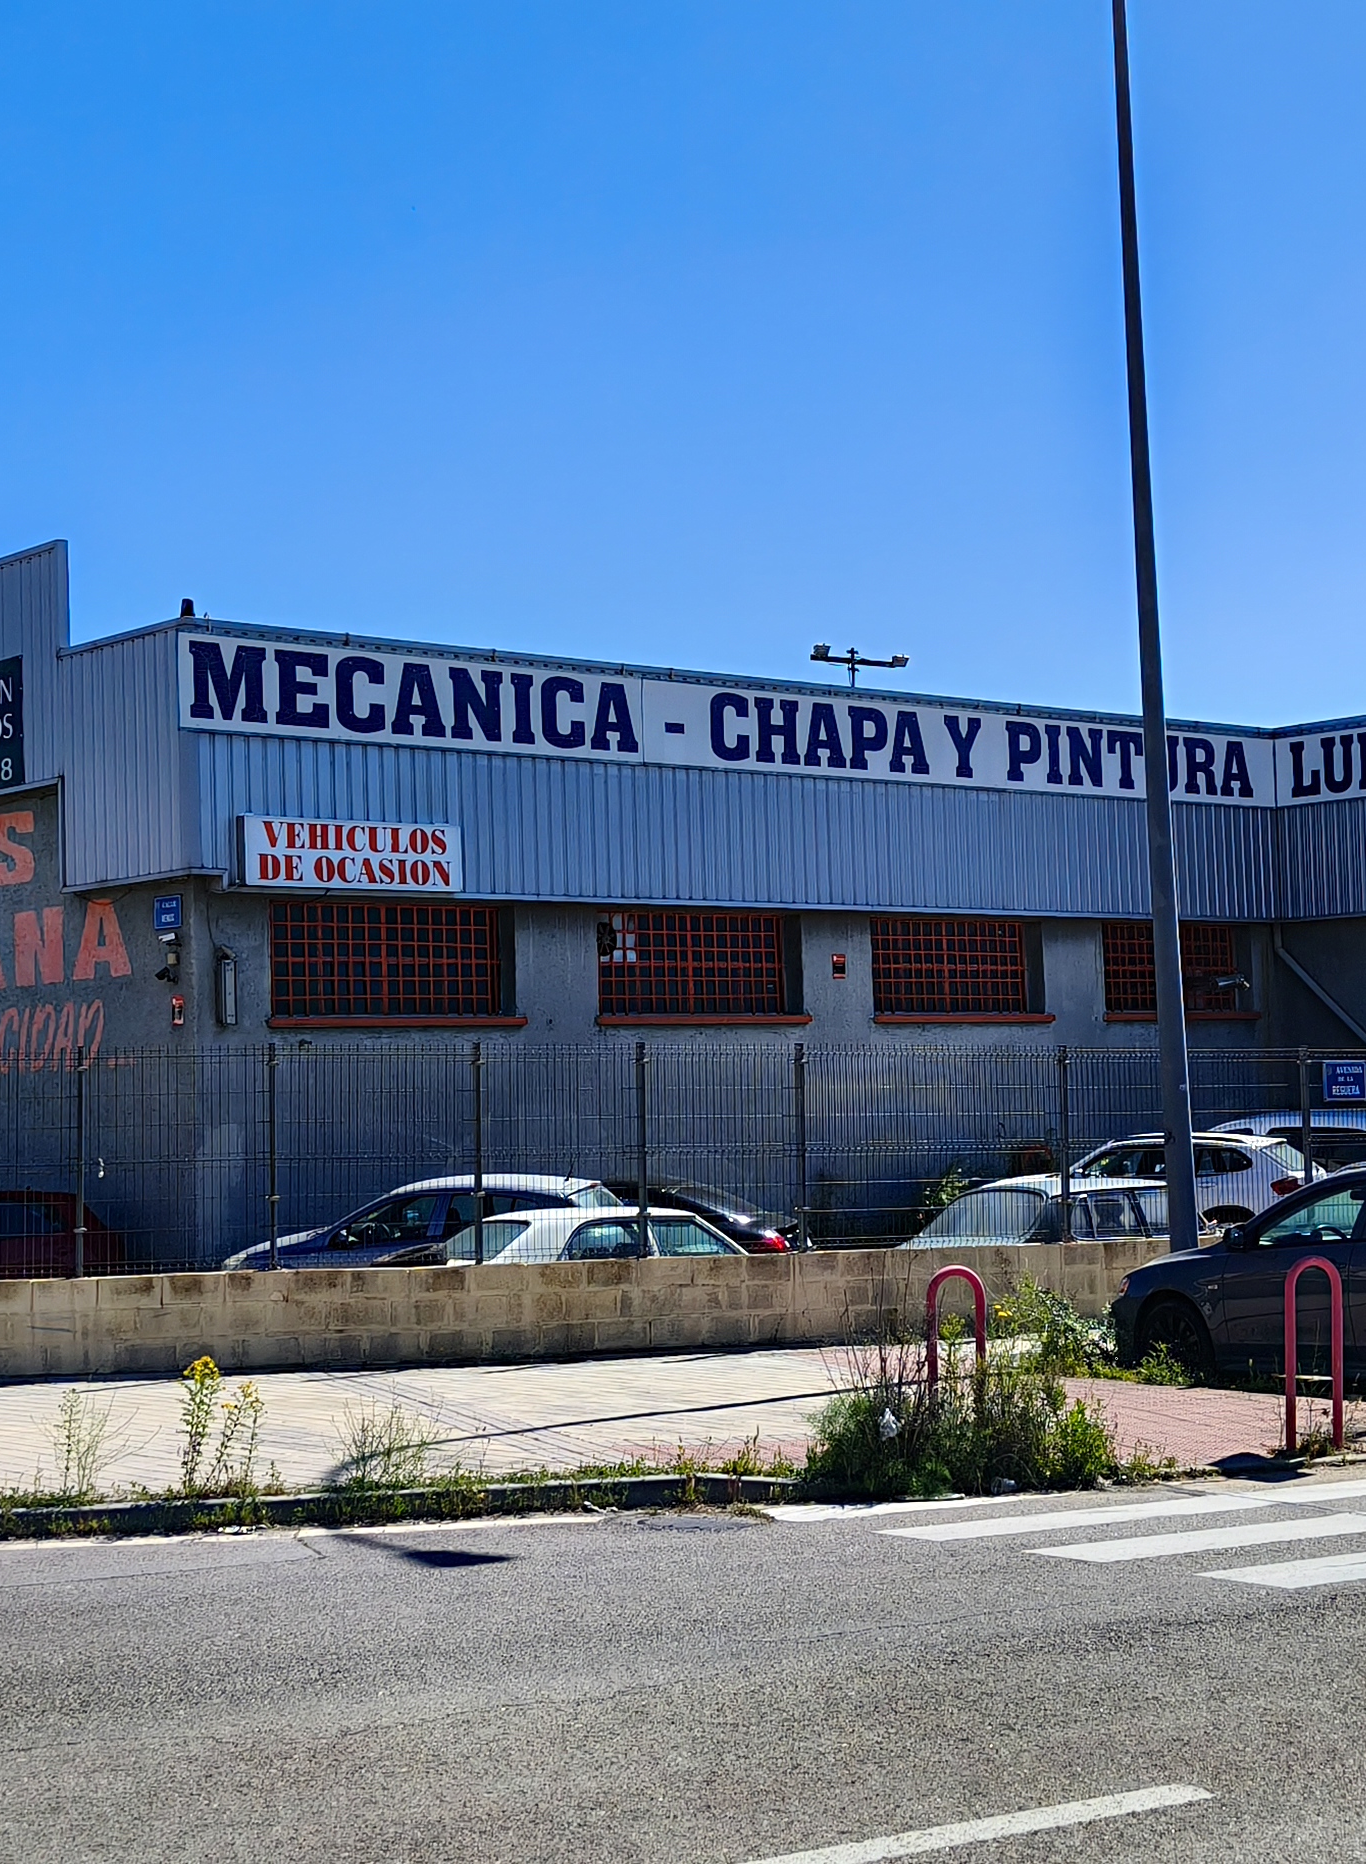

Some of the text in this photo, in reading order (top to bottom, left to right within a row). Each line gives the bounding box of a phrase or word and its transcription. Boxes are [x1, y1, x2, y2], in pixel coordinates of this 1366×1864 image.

[188, 640, 638, 753] MECANICA
[708, 692, 930, 775] CHAPA
[944, 715, 981, 778] Y
[262, 821, 447, 856] VEHICULOS
[257, 853, 451, 887] DE OCASION
